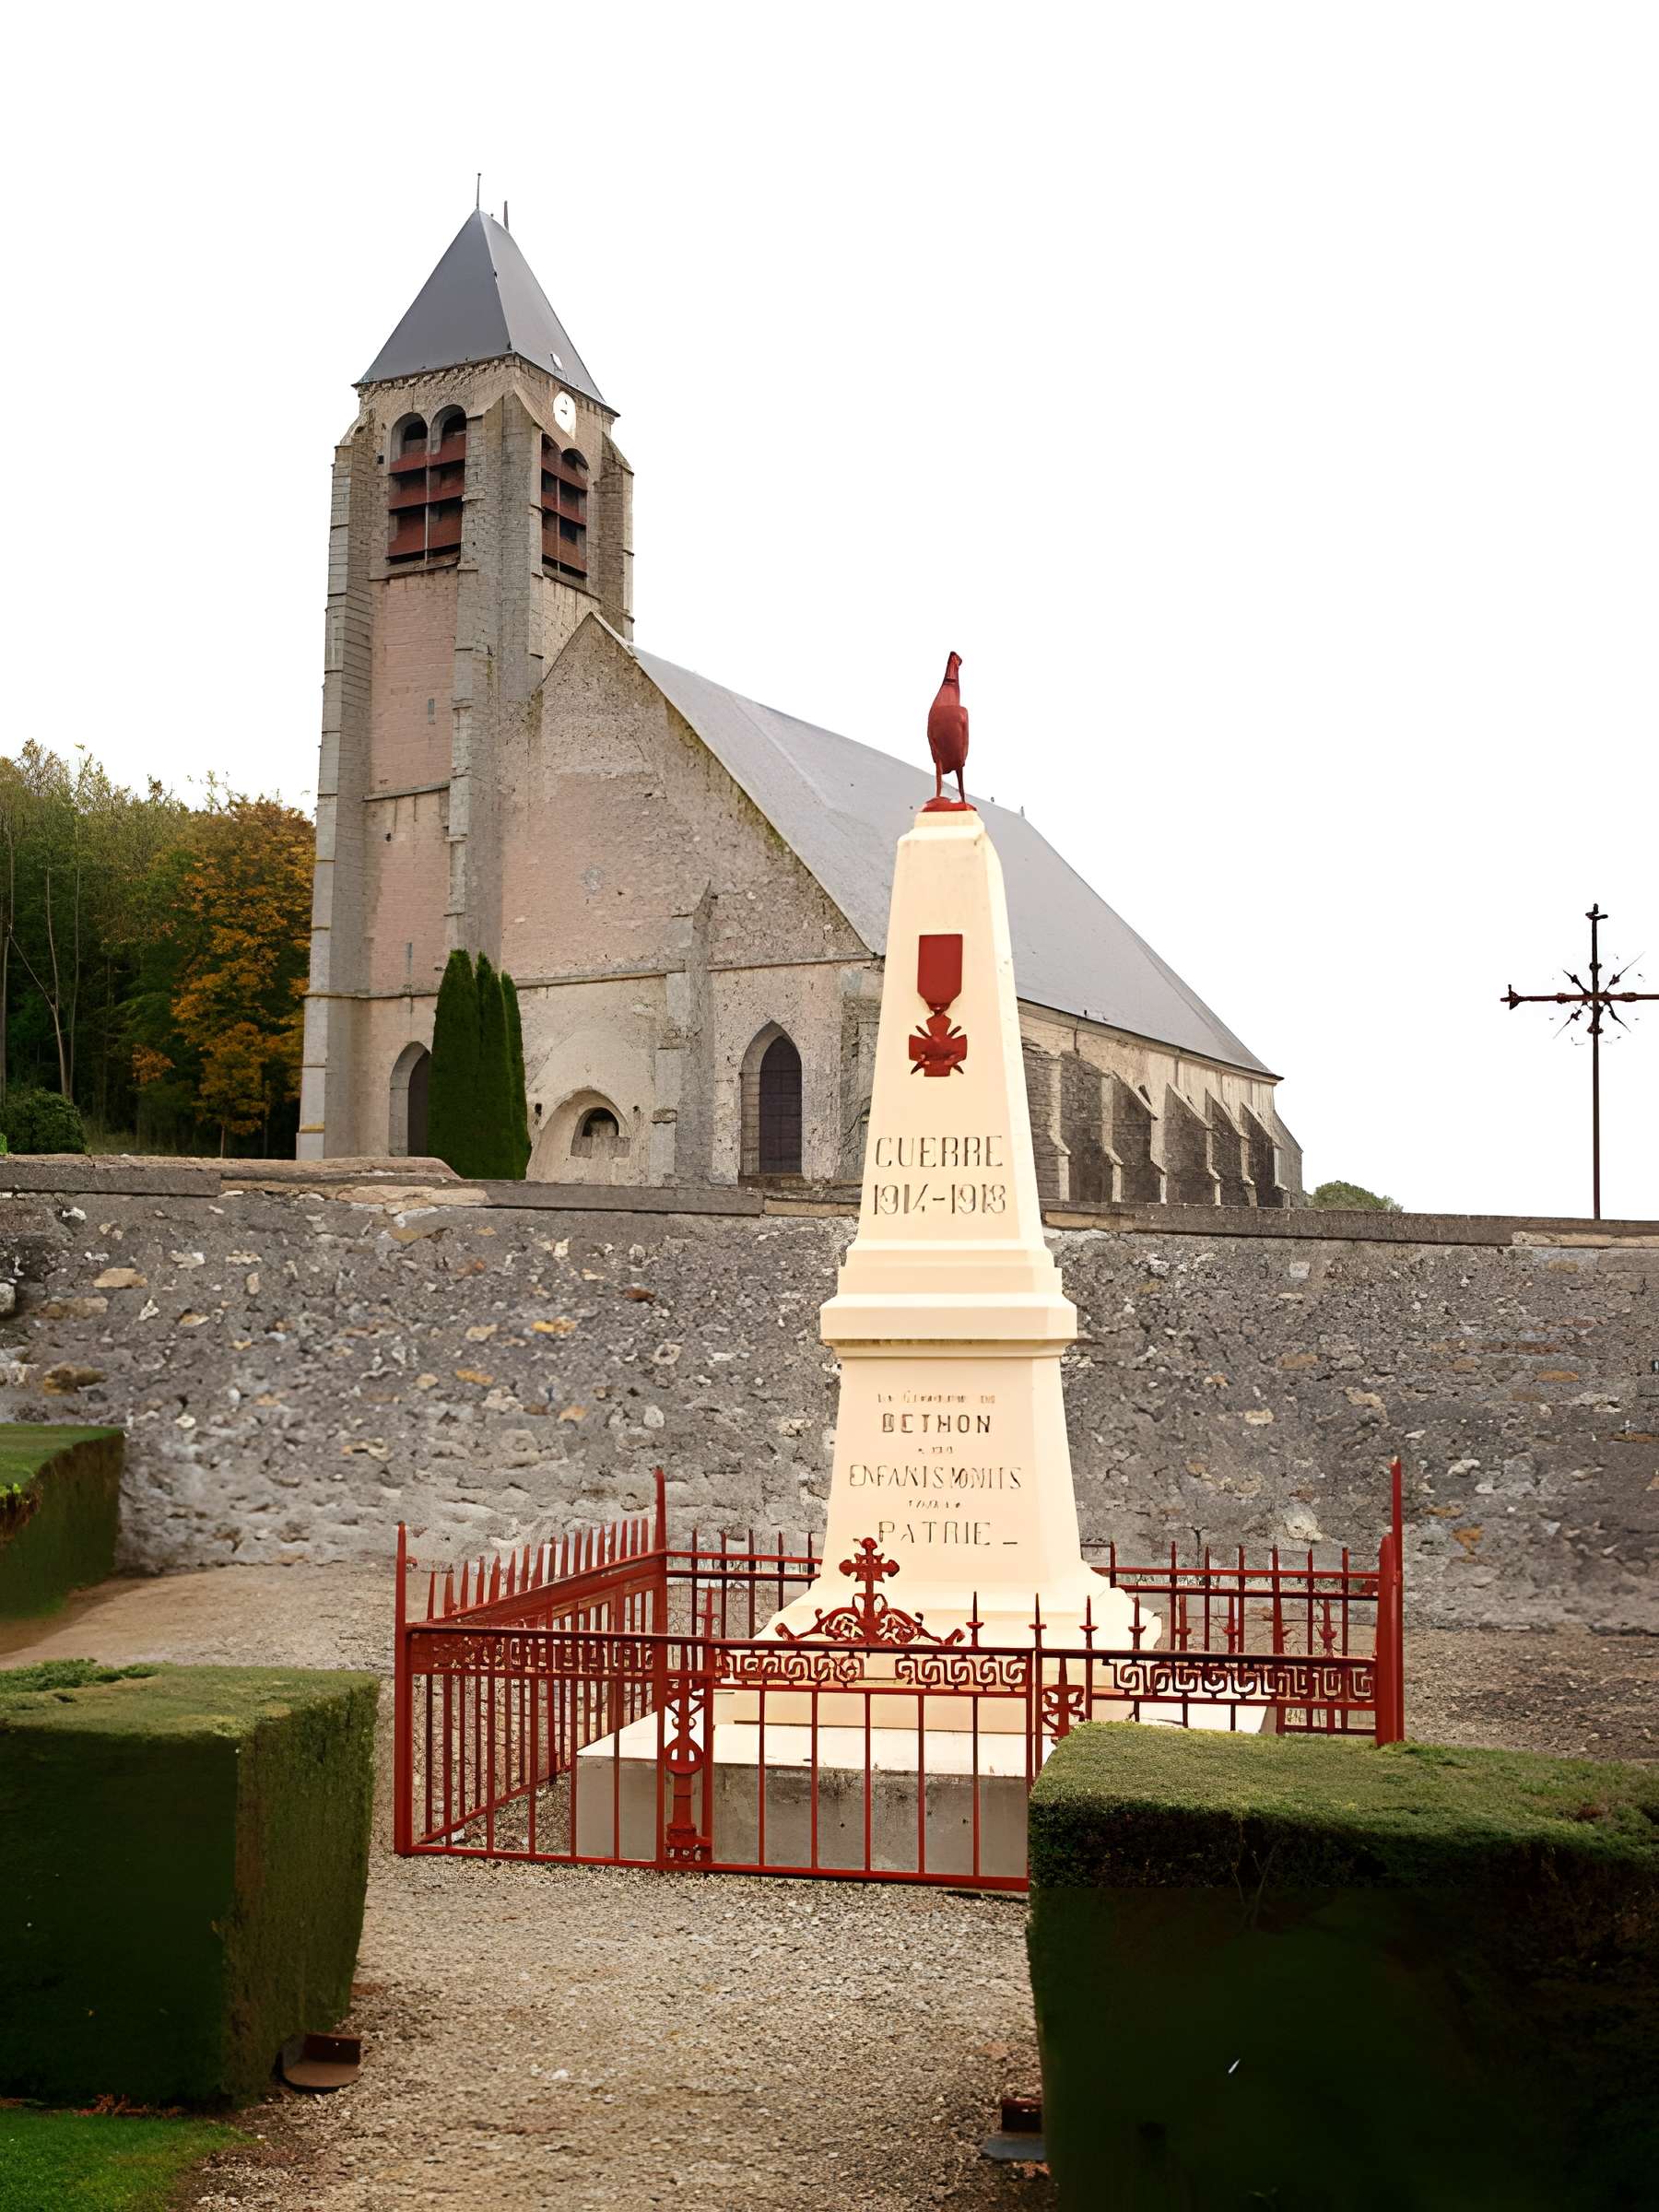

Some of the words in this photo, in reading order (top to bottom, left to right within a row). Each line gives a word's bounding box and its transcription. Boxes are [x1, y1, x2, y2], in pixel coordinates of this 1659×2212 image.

[875, 1135, 1004, 1168] GUERRE
[873, 1182, 1006, 1216] 1914-1918
[882, 1412, 991, 1433] BETHON
[878, 1521, 991, 1546] PATRIE
